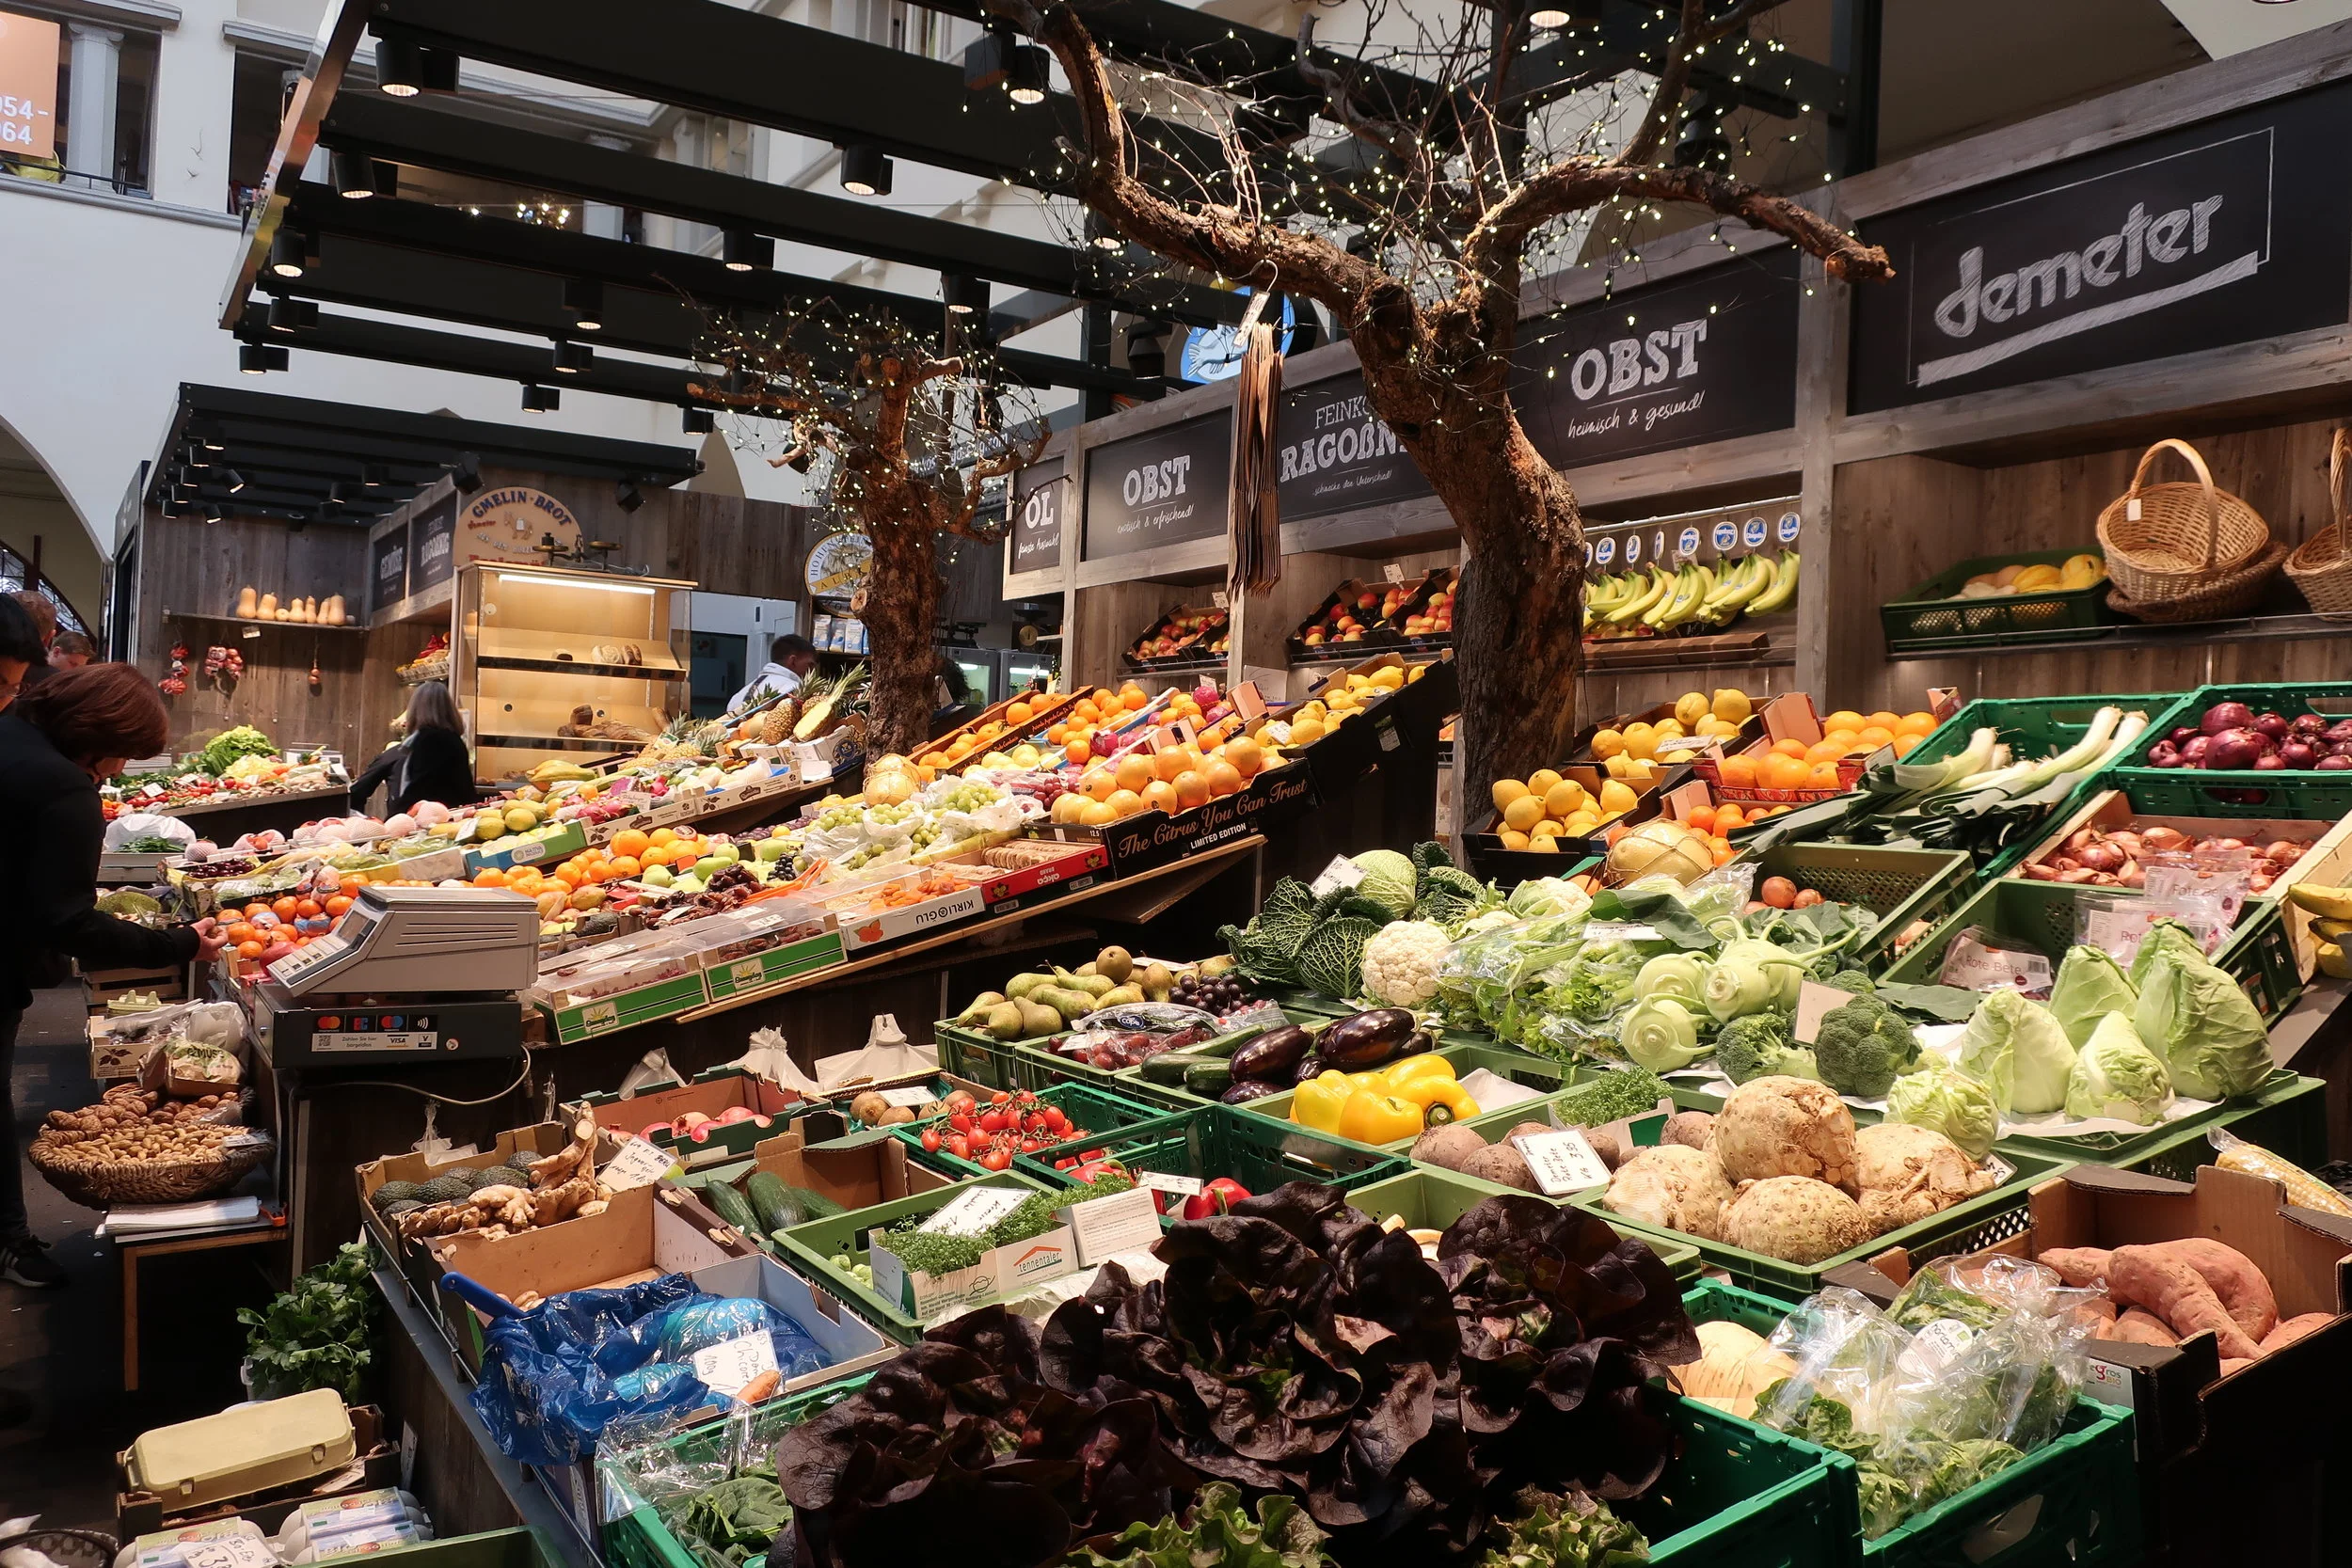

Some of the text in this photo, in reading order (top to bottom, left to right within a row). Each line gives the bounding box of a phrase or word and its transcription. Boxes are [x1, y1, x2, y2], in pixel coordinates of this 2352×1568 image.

[0, 96, 49, 120] 54-
[0, 120, 34, 146] 64
[1934, 194, 2223, 339] demeter
[1571, 319, 1708, 401] OBST
[1568, 407, 1620, 439] heimisch
[1629, 408, 1639, 426] &
[1279, 420, 1408, 483] RAGOßN
[1123, 454, 1191, 507] OBST
[1144, 515, 1150, 528] &
[1119, 779, 1309, 859] The Citrus You Can Trust
[1190, 822, 1247, 849] LIMITED EDITION
[2121, 930, 2143, 942] Rot
[1965, 956, 2023, 975] Rote Bete
[1019, 1251, 1060, 1273] tennentaler
